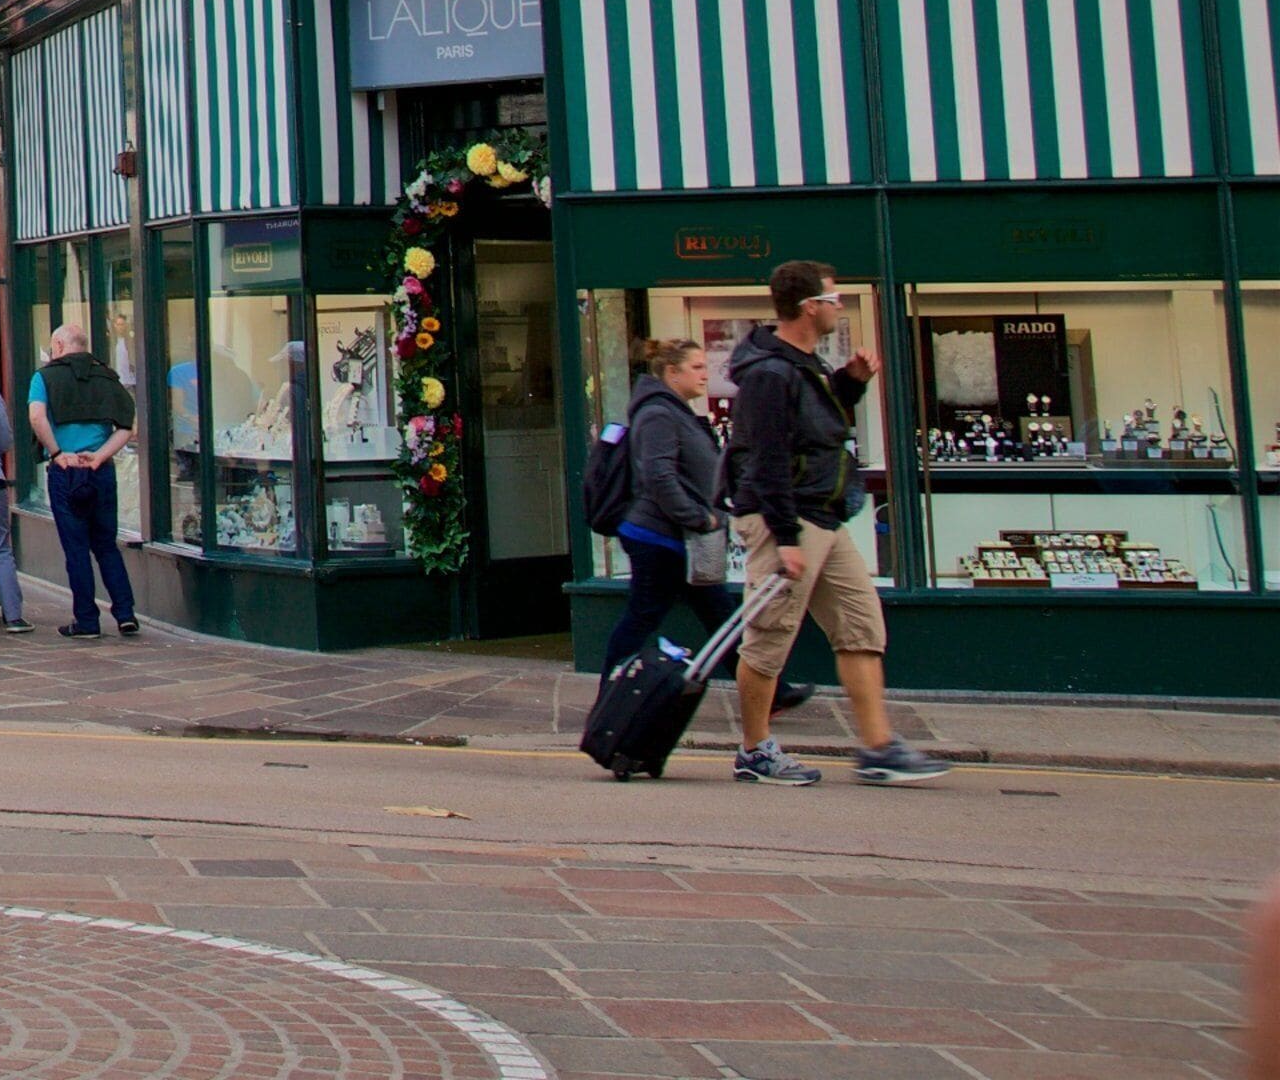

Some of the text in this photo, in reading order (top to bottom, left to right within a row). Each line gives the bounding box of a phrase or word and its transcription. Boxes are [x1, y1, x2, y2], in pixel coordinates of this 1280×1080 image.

[436, 44, 474, 60] PARIS
[685, 235, 761, 250] RIVOLI
[235, 251, 269, 265] RIVOLI
[1003, 322, 1056, 334] RADO
